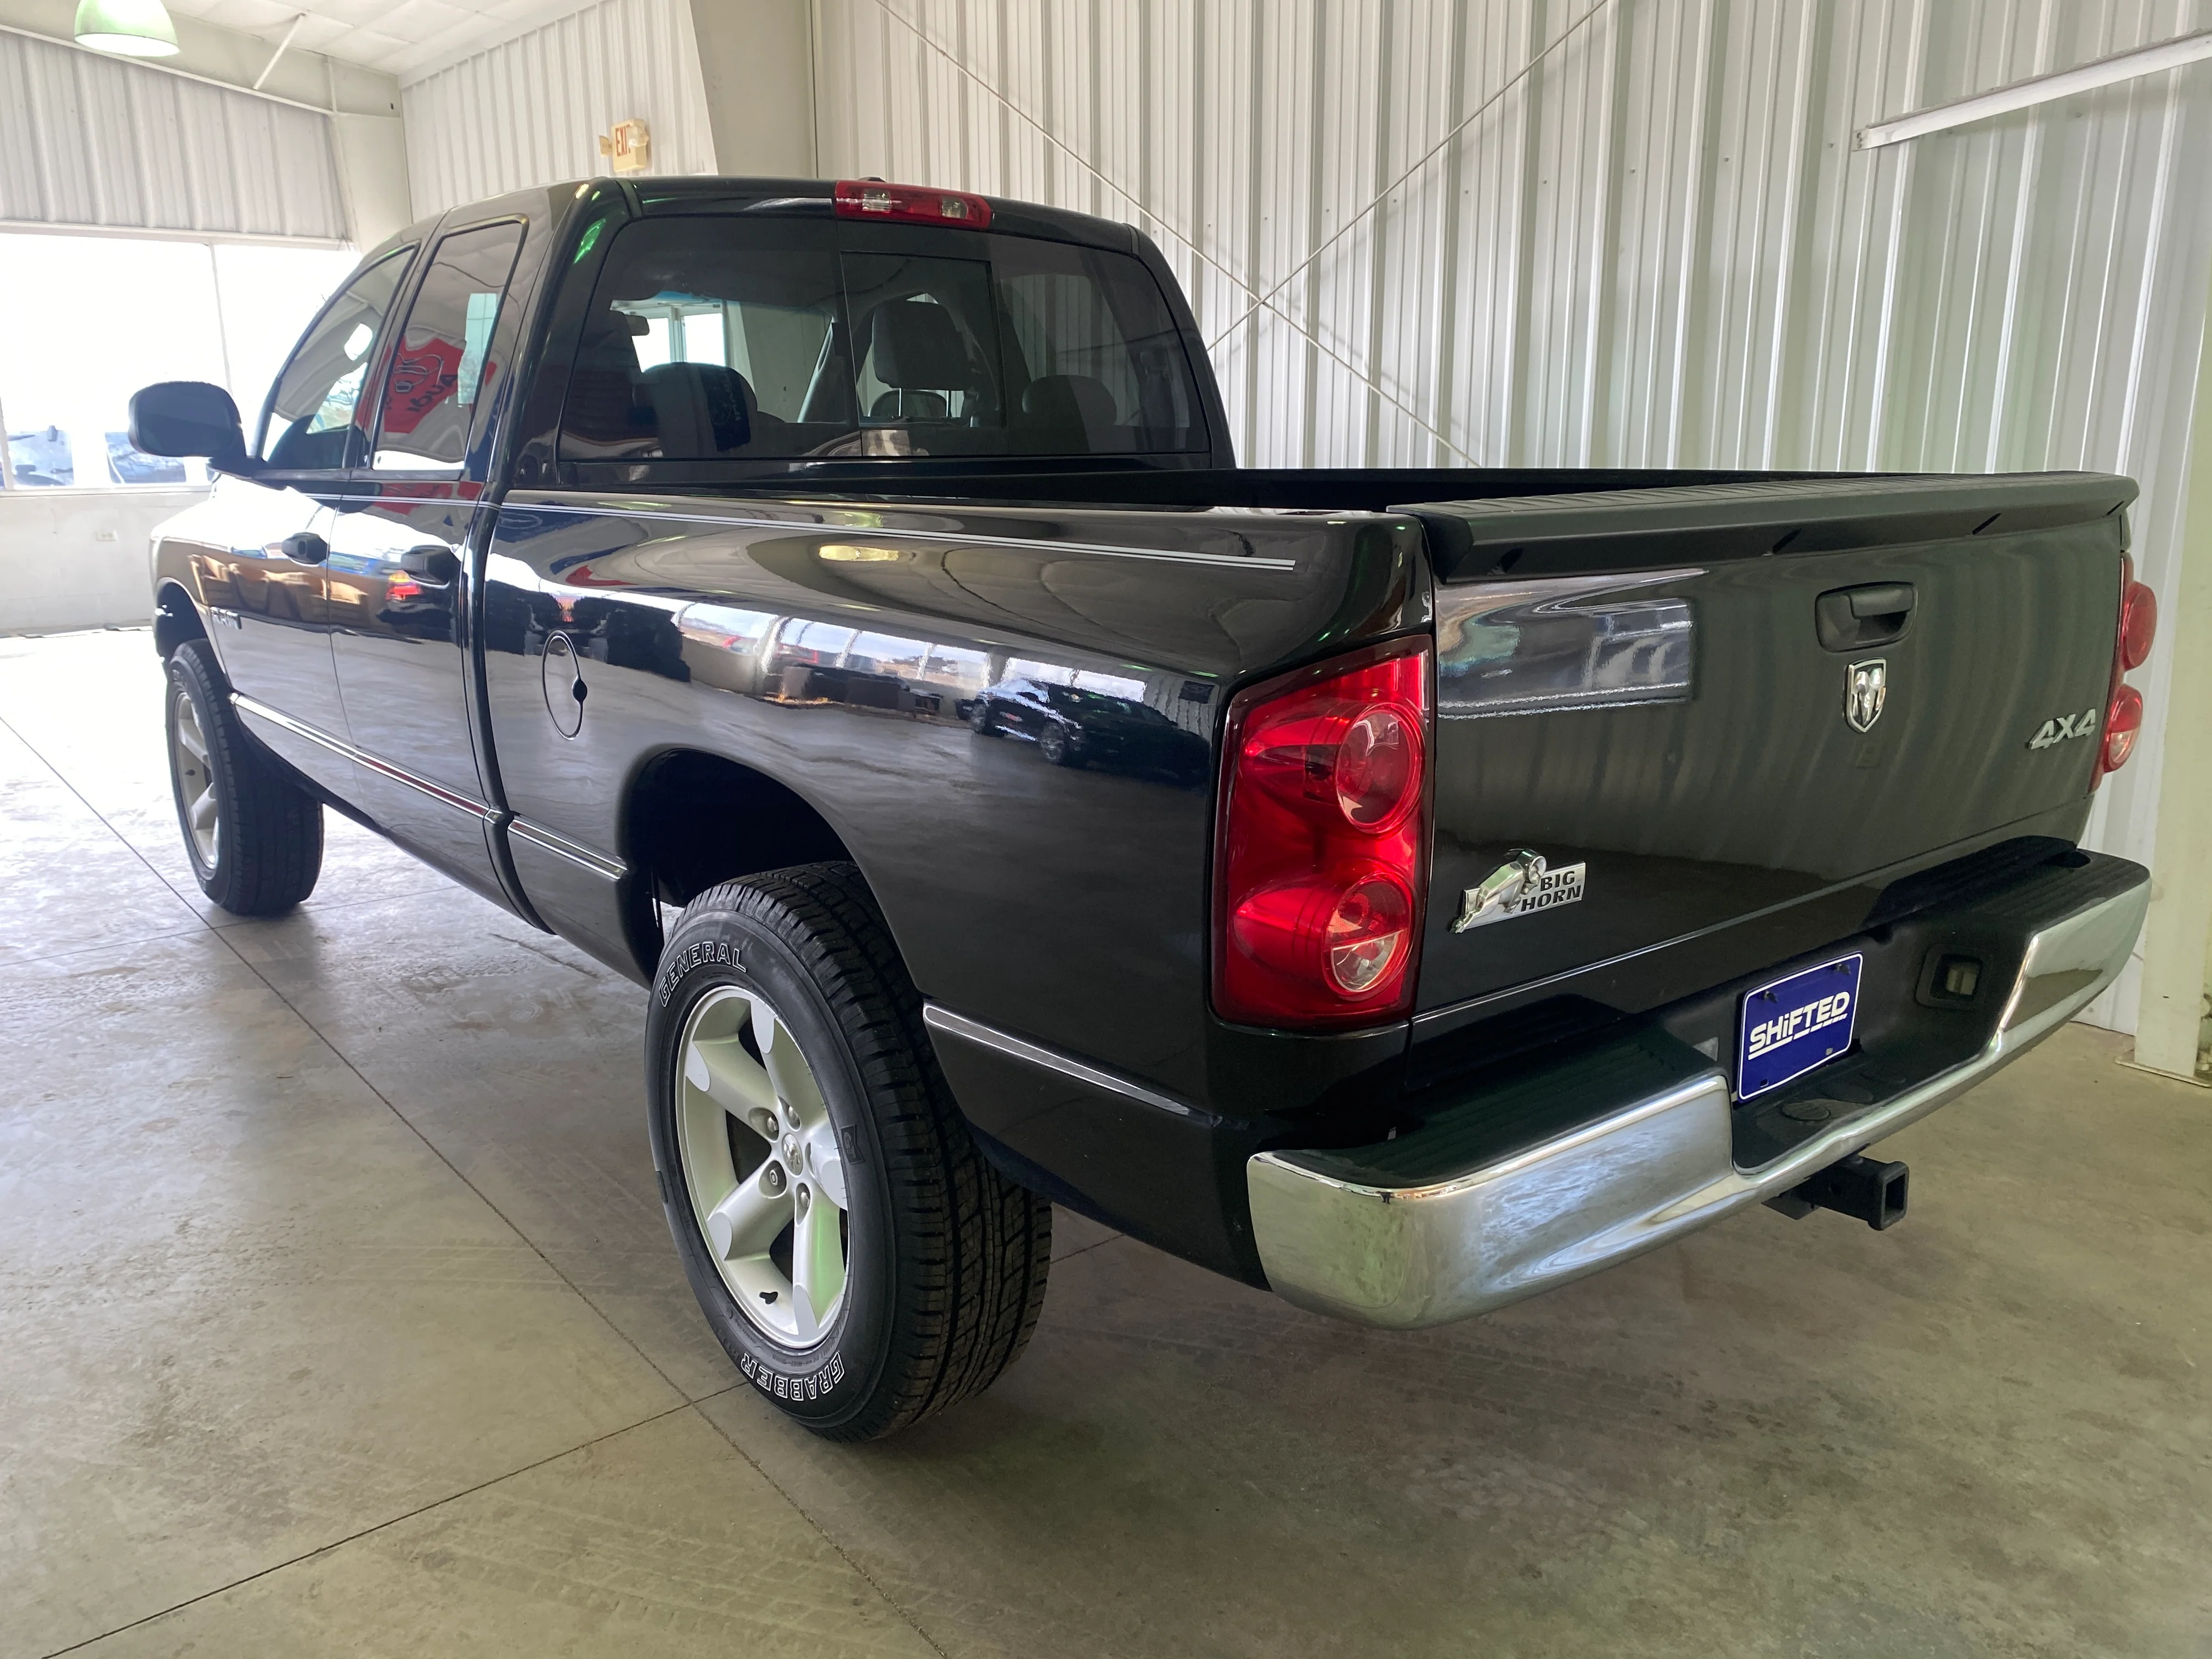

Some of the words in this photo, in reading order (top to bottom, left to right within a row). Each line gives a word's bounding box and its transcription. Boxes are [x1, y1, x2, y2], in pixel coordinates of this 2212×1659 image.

[1521, 884, 1582, 912] HORN
[1540, 870, 1576, 892] BIG
[658, 940, 747, 1008] GENERAL
[740, 1351, 845, 1402] GRABBER
